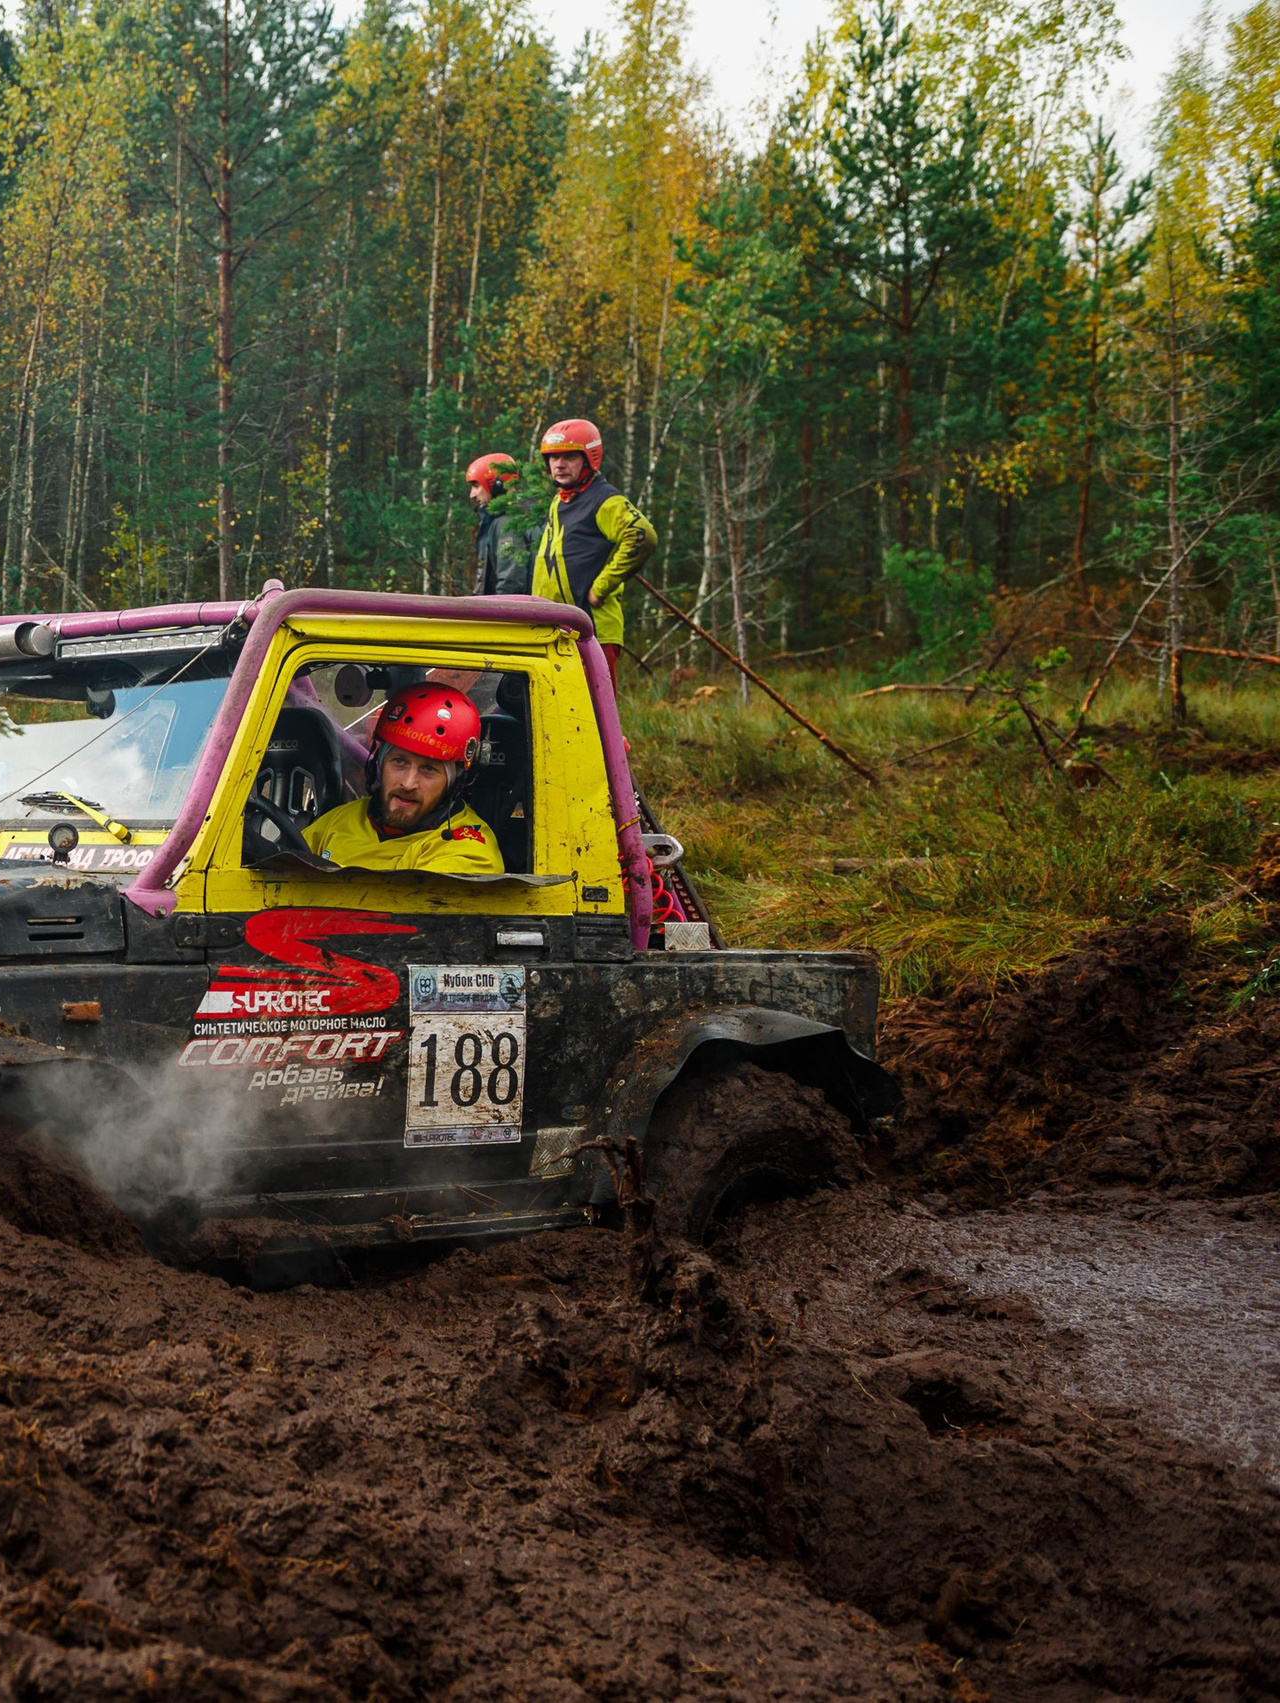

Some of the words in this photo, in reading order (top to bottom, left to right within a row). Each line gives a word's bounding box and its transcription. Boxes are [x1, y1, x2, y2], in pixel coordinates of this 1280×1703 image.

[99, 849, 154, 868] ТРОФ
[443, 973, 473, 988] Кубок
[475, 974, 495, 987] СПб
[231, 989, 331, 1014] SUPROTEC
[194, 1020, 288, 1036] СИНТЕТИЧЕСКОЕ
[290, 1018, 348, 1032] МОТОРНОЕ
[350, 1016, 387, 1030] МАСЛО
[178, 1031, 401, 1067] COMFORT
[248, 1063, 344, 1091] добавь
[418, 1032, 520, 1108] 188
[280, 1076, 385, 1107] драйва!
